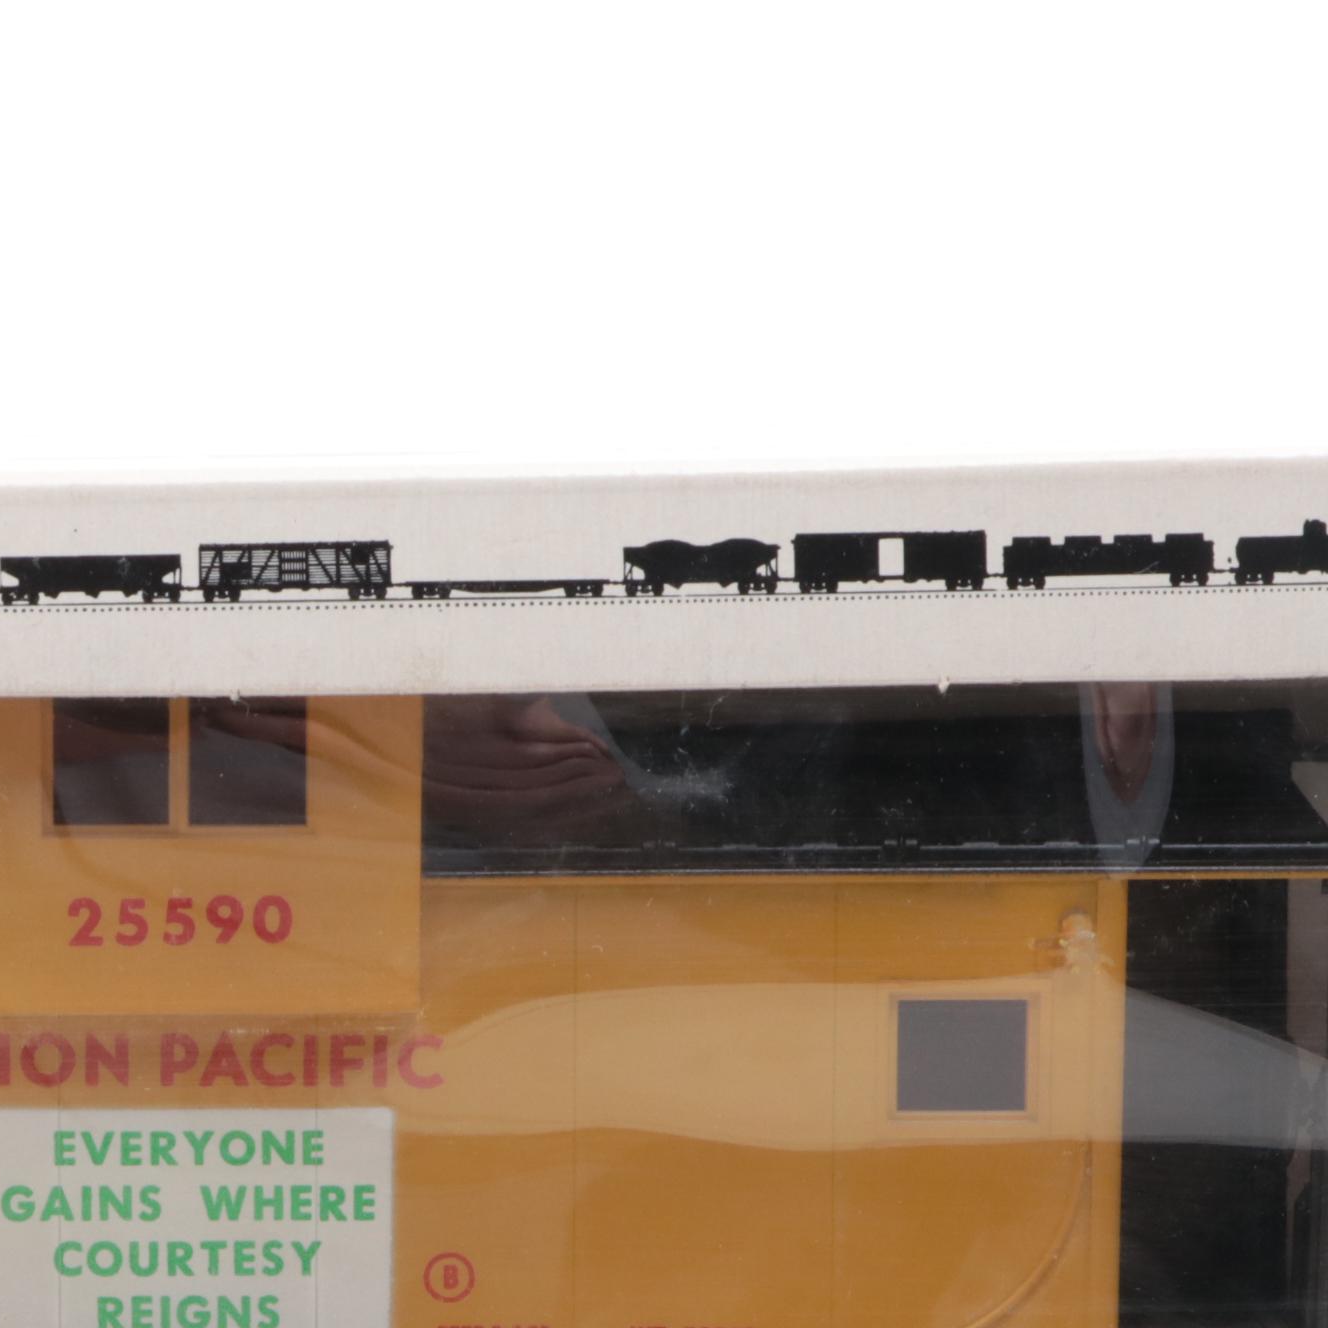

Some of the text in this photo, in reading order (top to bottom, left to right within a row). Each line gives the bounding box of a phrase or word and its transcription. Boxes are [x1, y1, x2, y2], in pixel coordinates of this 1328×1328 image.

[67, 894, 293, 947] 25590
[160, 1032, 445, 1088] PACIFIC
[54, 1130, 324, 1166] EVERYONE
[1, 1184, 376, 1223] GAINS WHERE
[54, 1240, 322, 1277] COURTESY
